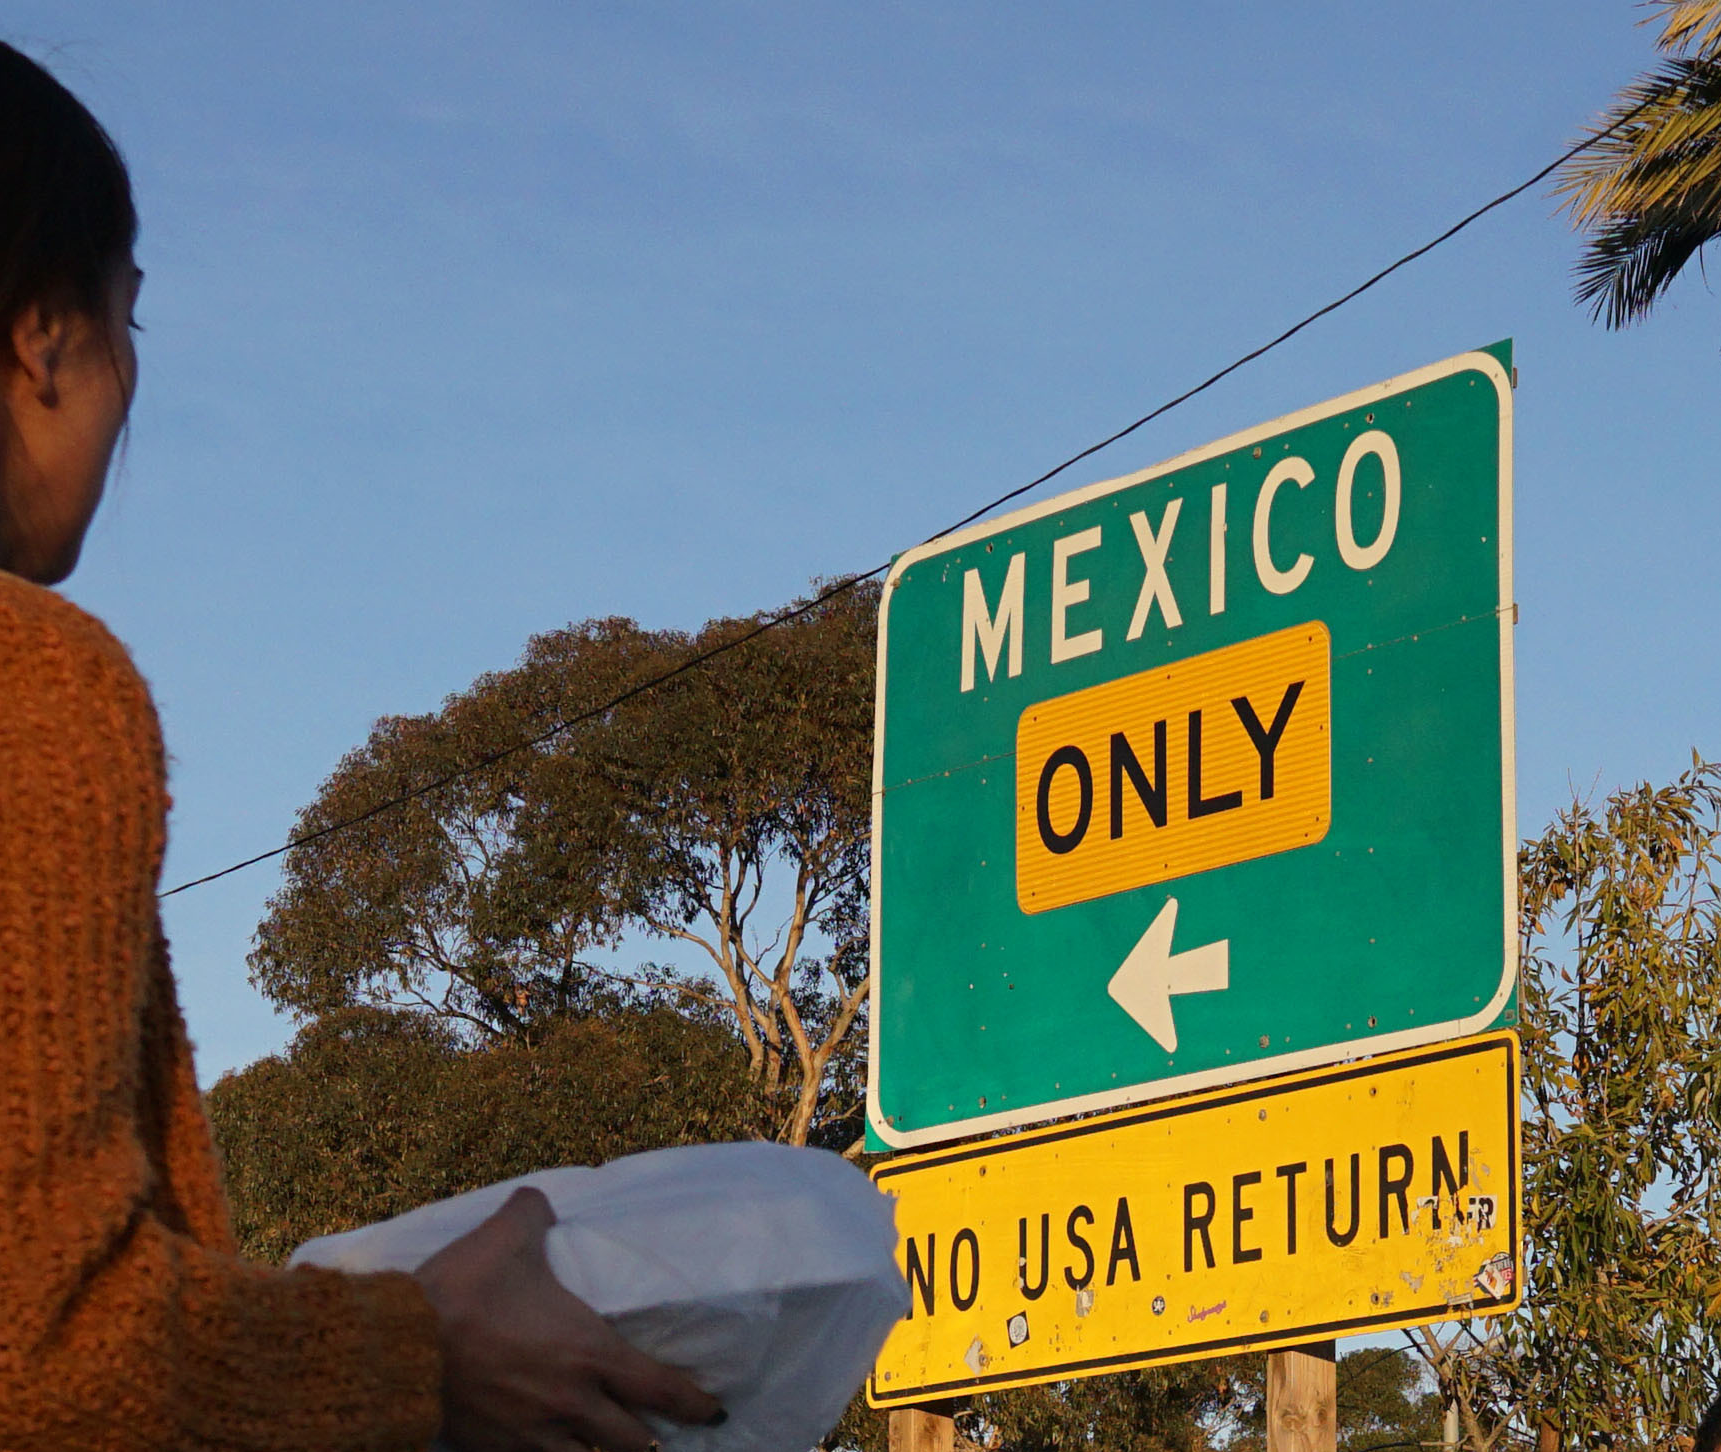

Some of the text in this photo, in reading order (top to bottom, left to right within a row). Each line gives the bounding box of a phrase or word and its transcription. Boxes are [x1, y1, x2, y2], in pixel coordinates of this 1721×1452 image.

[960, 430, 1401, 692] MEXICO
[1036, 680, 1306, 855] ONLY
[906, 1130, 1469, 1320] NO USA RETURN
